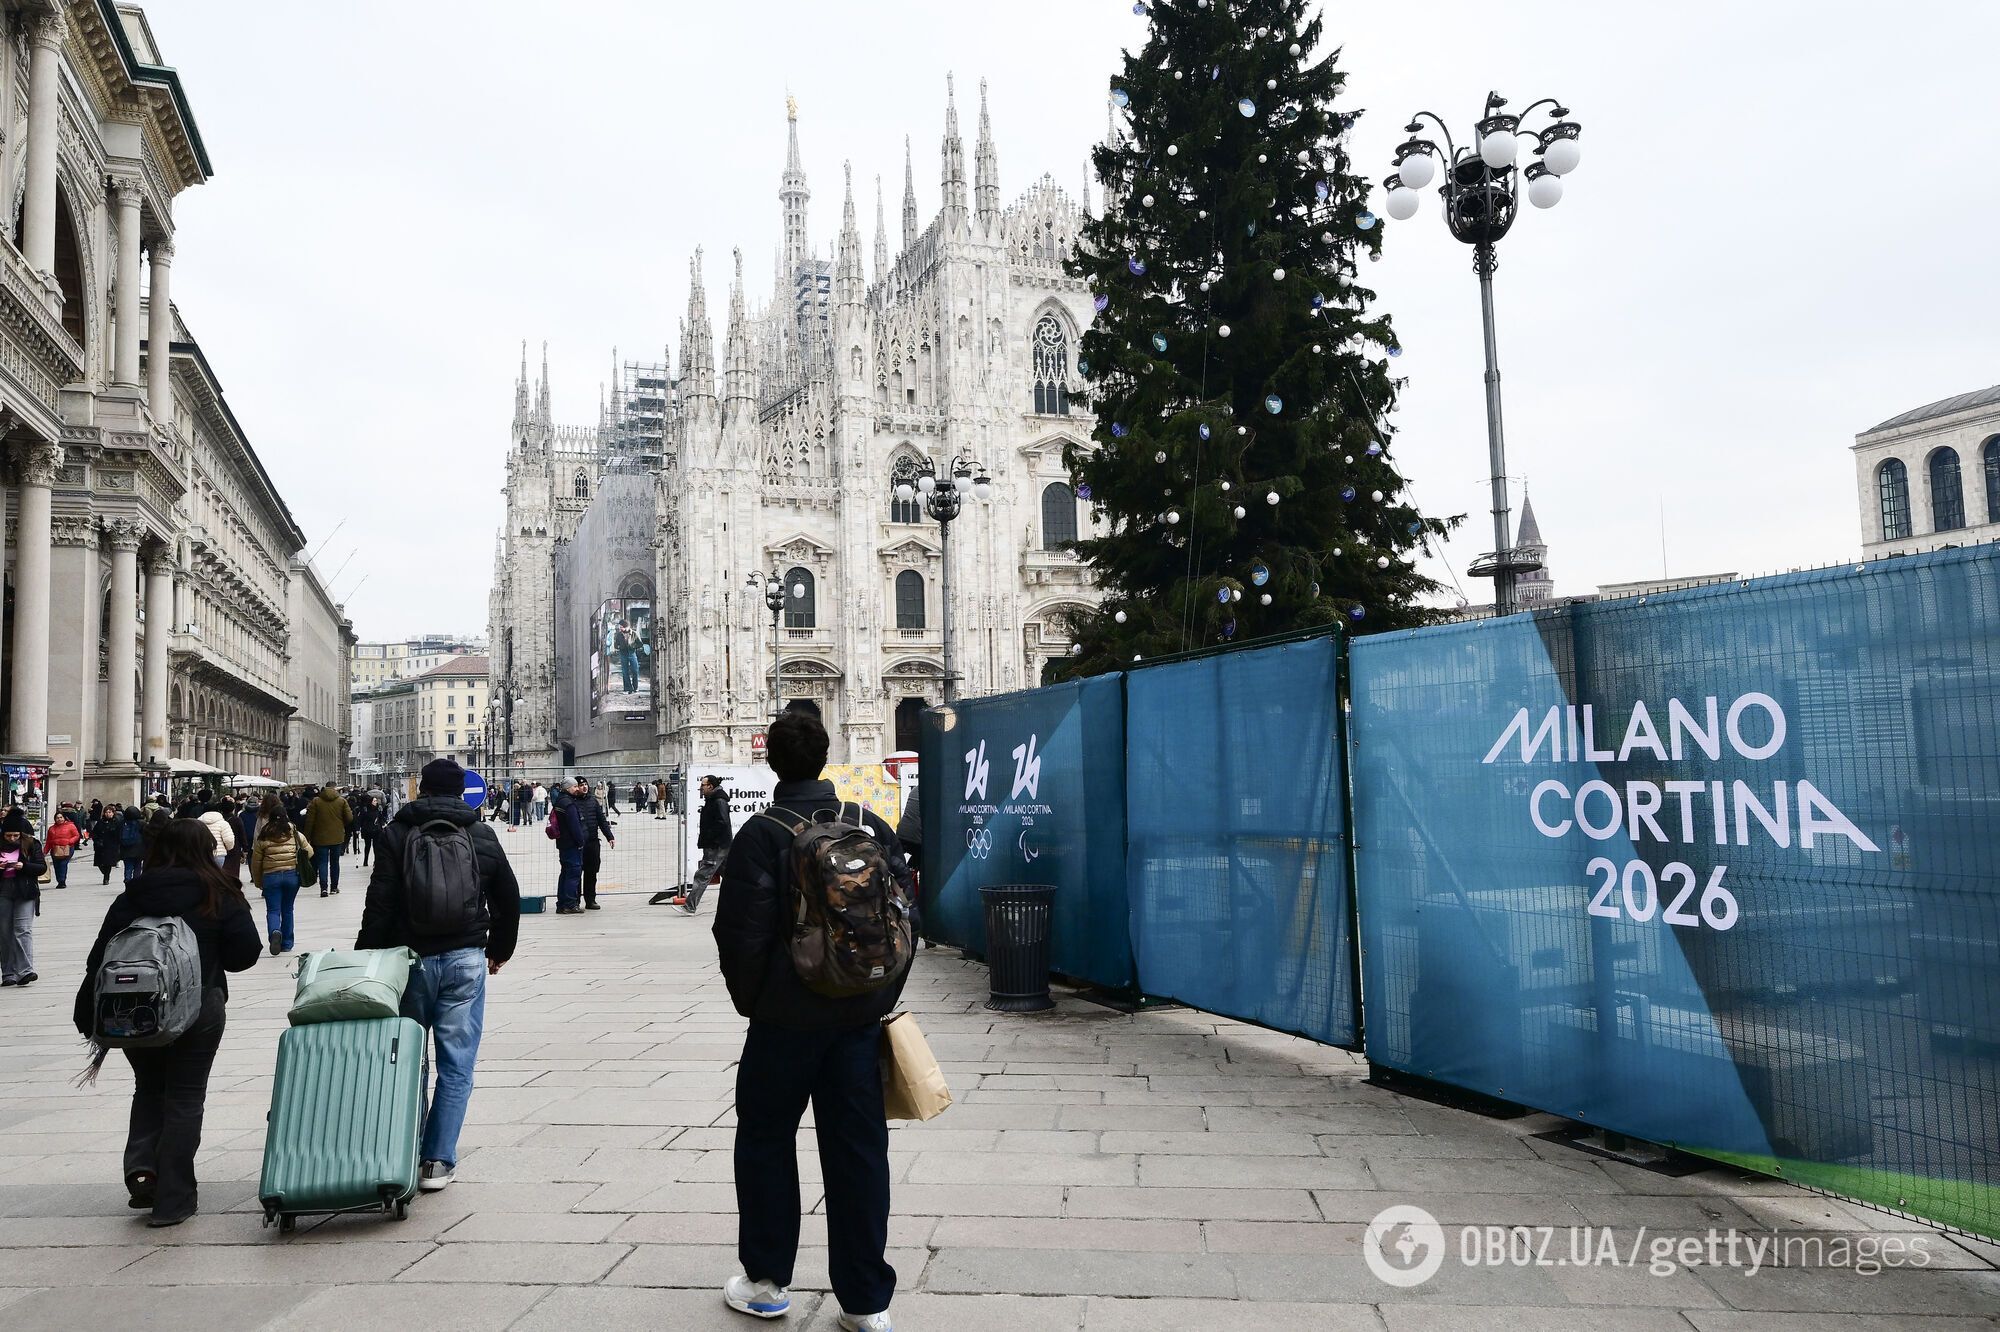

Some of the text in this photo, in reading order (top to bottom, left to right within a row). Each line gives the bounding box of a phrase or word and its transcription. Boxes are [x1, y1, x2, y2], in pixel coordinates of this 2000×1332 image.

[1482, 692, 1787, 764] MILANO
[753, 736, 765, 746] M
[729, 788, 767, 799] Home
[743, 801, 757, 813] of
[959, 804, 1000, 814] MILANO CORTINA
[1003, 804, 1053, 815] MILANO CORTINA
[973, 815, 983, 825] 2026
[1021, 815, 1034, 826] 2026
[1530, 779, 1881, 852] CORTINA
[1586, 857, 1739, 931] 2026
